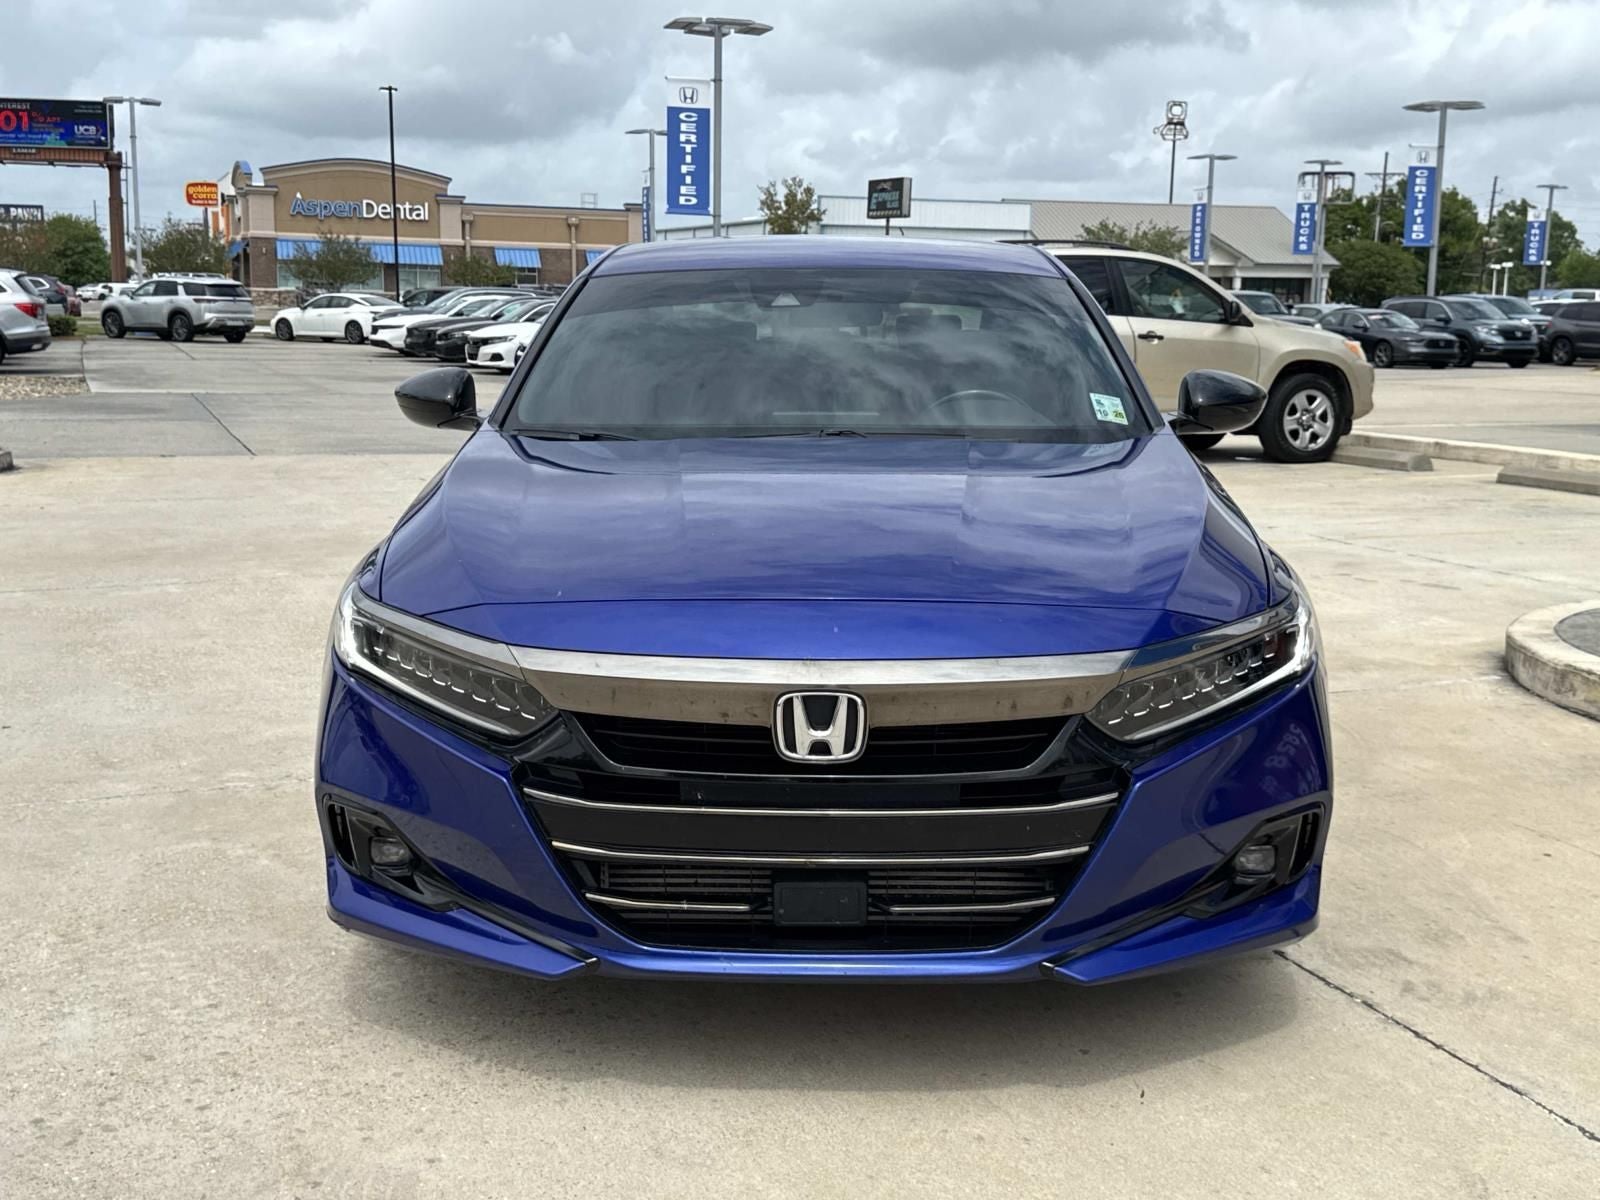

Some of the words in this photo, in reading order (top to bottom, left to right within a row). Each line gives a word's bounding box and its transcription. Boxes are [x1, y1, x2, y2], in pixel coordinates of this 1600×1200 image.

[74, 125, 97, 135] UCB
[678, 111, 698, 205] CERTIFIED
[187, 184, 217, 194] golden
[1411, 169, 1429, 240] CERTIFIED
[1298, 204, 1311, 251] TRUCKS
[1528, 222, 1541, 261] TRUCKS
